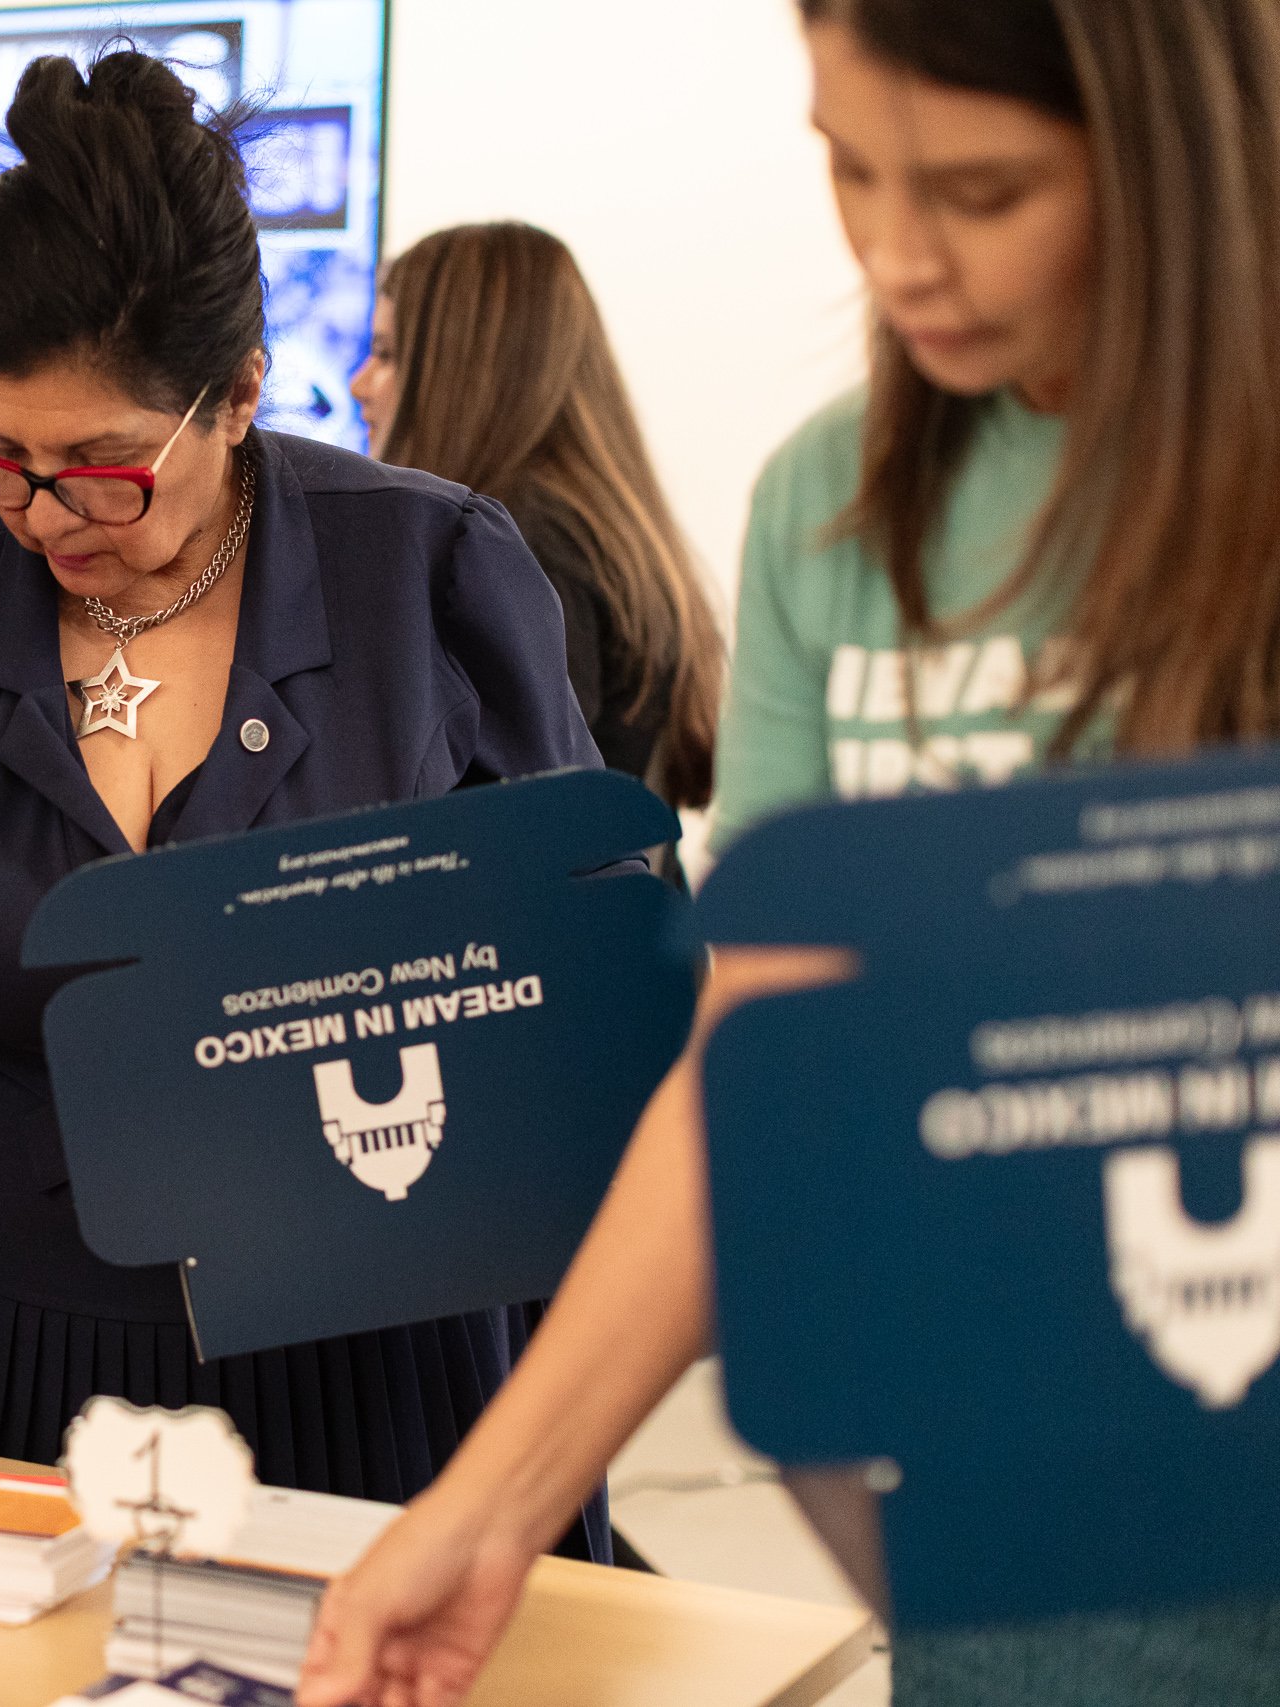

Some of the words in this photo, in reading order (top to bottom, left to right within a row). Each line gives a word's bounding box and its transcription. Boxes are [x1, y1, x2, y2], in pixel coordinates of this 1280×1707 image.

[390, 953, 456, 985] New
[461, 942, 499, 971] by
[221, 967, 385, 1016] Comienzos
[402, 974, 544, 1031] DREAM
[194, 1012, 347, 1069] MEXICO
[353, 1003, 396, 1039] IN
[114, 1428, 197, 1519] 1
